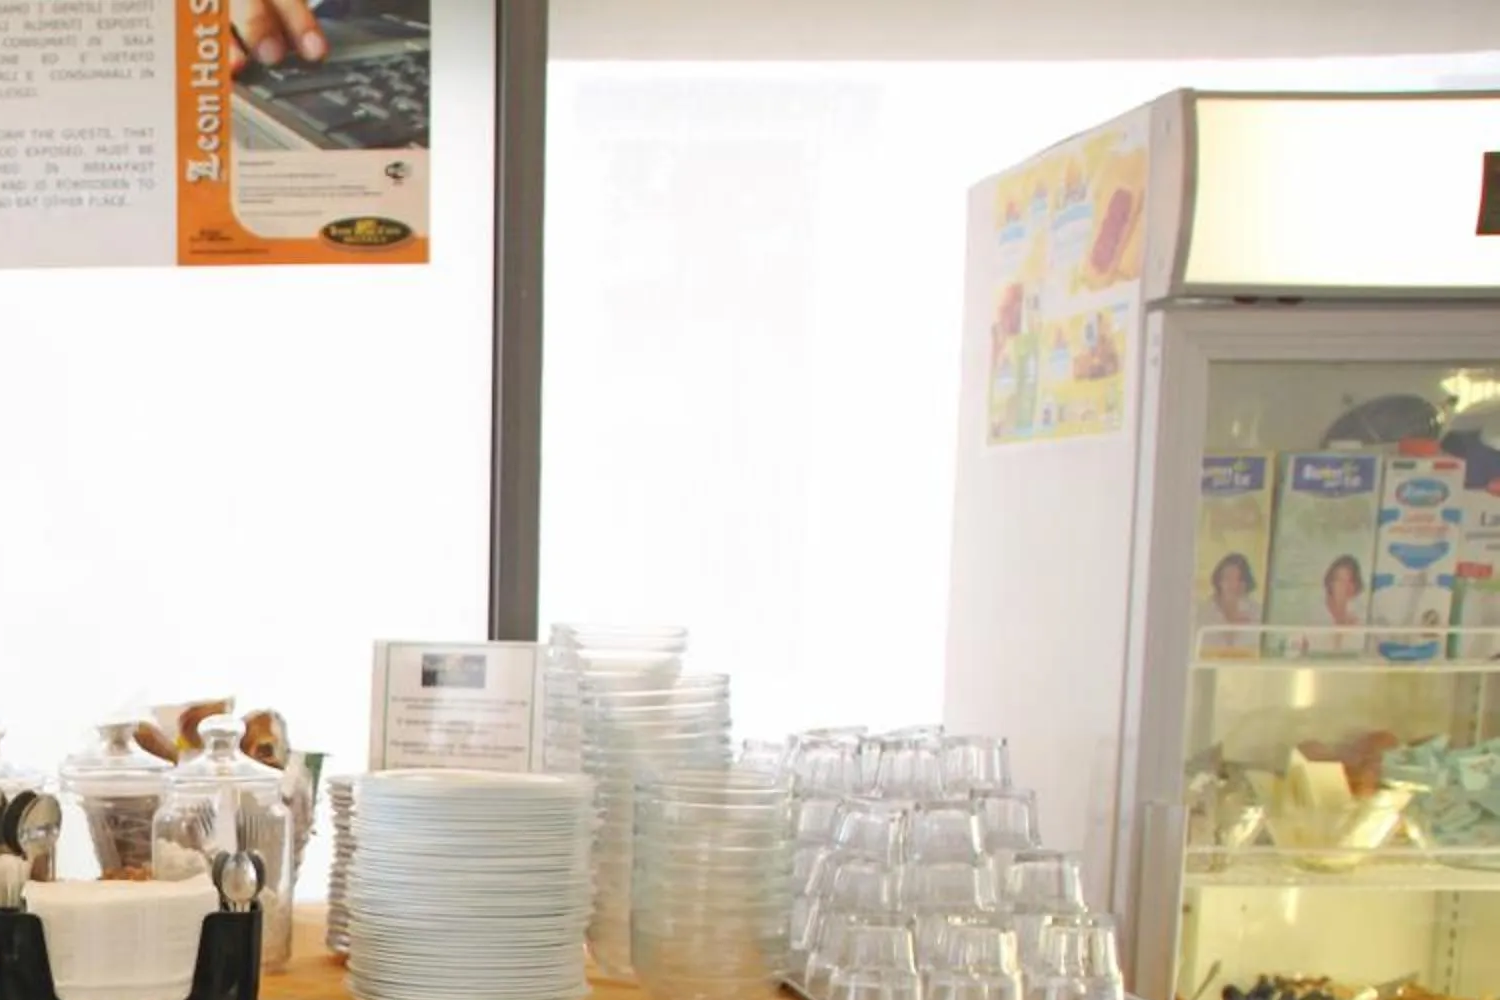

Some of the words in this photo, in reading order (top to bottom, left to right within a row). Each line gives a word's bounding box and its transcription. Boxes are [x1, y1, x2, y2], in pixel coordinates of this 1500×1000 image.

[1, 35, 77, 48] CONSUMATI
[87, 35, 101, 47] IN
[123, 34, 154, 46] SALA
[41, 53, 59, 65] ED
[102, 51, 154, 63] VIETATO
[190, 23, 220, 88] Hot
[25, 70, 33, 82] E
[140, 68, 154, 79] IN
[30, 128, 54, 139] THE
[123, 127, 154, 138] THAT
[185, 94, 221, 183] Leon
[96, 143, 129, 155] MUST
[138, 143, 154, 155] BE
[45, 162, 59, 173] IN
[83, 161, 154, 173] BREAKFAST
[1, 179, 27, 190] AND
[137, 178, 156, 189] TO
[16, 196, 38, 207] EAT
[42, 195, 84, 207] OTHER
